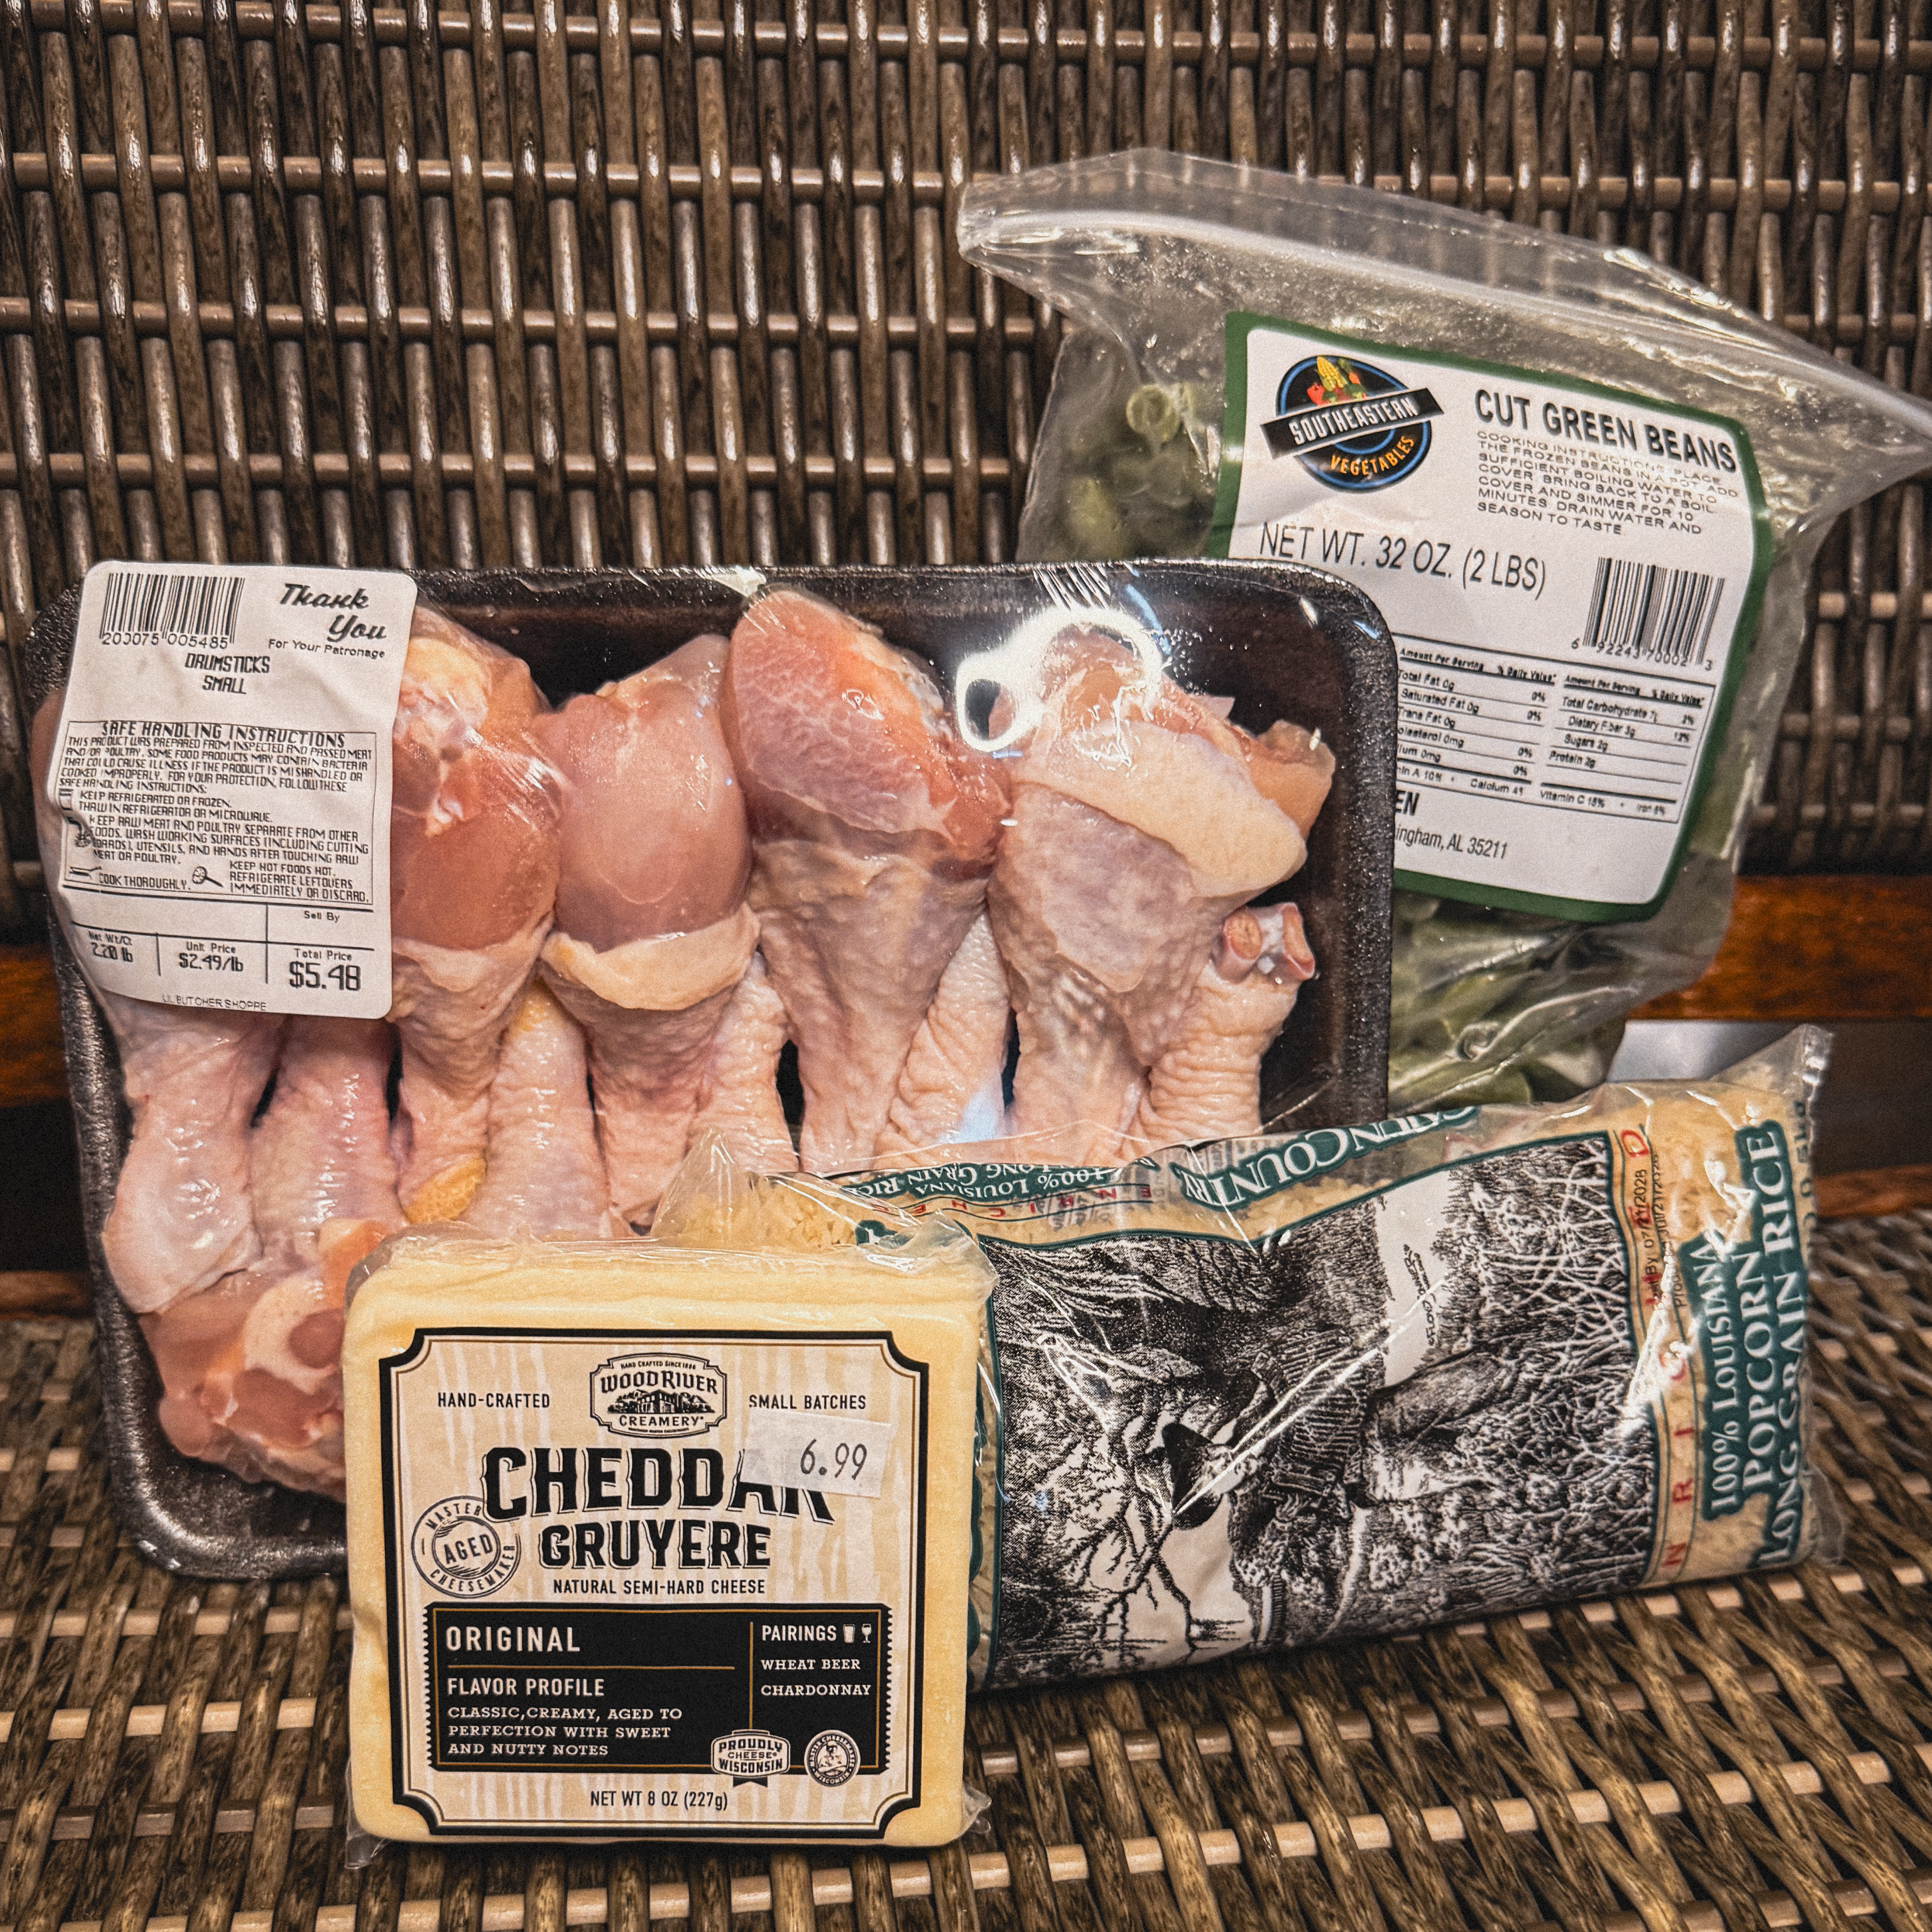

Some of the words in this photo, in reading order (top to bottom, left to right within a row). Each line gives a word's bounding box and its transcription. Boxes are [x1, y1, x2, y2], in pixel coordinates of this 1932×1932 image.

[1289, 397, 1418, 445] SOUTHEASTERN
[1475, 389, 1530, 430] CUT
[1542, 402, 1637, 450] GREEN
[1644, 424, 1736, 473] BEANS
[1478, 431, 1548, 450] COOKING
[1330, 436, 1414, 476] VEGETABLES
[1479, 440, 1507, 453] THE
[1513, 447, 1575, 465] FROZEN
[1581, 461, 1631, 476] BEANS
[1707, 485, 1738, 497] ADD
[1479, 453, 1568, 475] SUFFICIENT
[1575, 470, 1633, 487] BOILING
[1638, 482, 1692, 500] WATER
[1698, 494, 1717, 504] TO
[1479, 464, 1533, 480] COVER
[1544, 475, 1590, 490] BRING
[1596, 484, 1636, 498] BACK
[1643, 493, 1661, 503] TO
[1666, 497, 1675, 506] A
[1681, 499, 1714, 514] BOIL
[1479, 476, 1533, 493] COVER
[1538, 487, 1571, 500] AND
[1577, 493, 1635, 511] SIMMER
[1642, 505, 1671, 518] FOR
[1679, 512, 1693, 522] 10
[1478, 502, 1542, 521] SEASON
[1548, 514, 1568, 525] TO
[1574, 518, 1621, 535] TASTE
[1479, 488, 1547, 508] MINUTES
[1557, 502, 1604, 518] DRAIN
[1609, 511, 1665, 528] WATER
[1669, 522, 1702, 534] AND
[1260, 522, 1315, 560] NET
[1322, 528, 1365, 567] WT.
[1375, 535, 1407, 570] 32
[1413, 540, 1452, 579] OZ.
[1462, 547, 1486, 590] (2
[1492, 551, 1546, 601] LBS)
[279, 583, 369, 610] Thank
[326, 615, 387, 642] You
[168, 633, 228, 649] 005485
[268, 638, 288, 649] For
[293, 640, 321, 652] Your
[324, 644, 385, 660] Patronage
[184, 653, 270, 673] DRUMSTICKS
[1705, 660, 1712, 671] 3
[202, 675, 247, 695] SMALL
[101, 721, 137, 736] SAFE
[142, 722, 222, 739] HANDLING
[229, 724, 346, 748] INSTRUCTIONS
[108, 792, 175, 804] REFRIGERATED
[177, 795, 190, 805] OR
[192, 796, 232, 808] FROZEN.
[1446, 834, 1464, 853] AL
[1467, 837, 1507, 859] 35211
[230, 860, 256, 870] KEEP
[260, 862, 277, 871] HOT
[281, 864, 312, 875] FOODS
[315, 867, 336, 877] HOT.
[124, 875, 191, 890] THOROUGHLY.
[304, 910, 322, 920] Sell
[327, 912, 340, 923] By
[88, 931, 102, 941] Net
[186, 941, 205, 952] Unit
[211, 943, 236, 954] Price
[294, 948, 322, 960] Total
[327, 950, 352, 962] Price
[121, 947, 134, 963] lb
[179, 953, 244, 972] $2.49/lb
[289, 961, 361, 991] $5.48
[176, 995, 223, 1007] BUTCHER
[225, 999, 267, 1011] SHOPPE
[907, 1164, 977, 1186] GRAIN
[1037, 1167, 1107, 1190] 100%
[915, 1178, 1027, 1200] LOUISIANA
[1747, 1131, 1795, 1256] RICE
[1646, 1257, 1660, 1274] By
[1690, 1242, 1739, 1412] LOUISIANA
[1772, 1271, 1807, 1430] GRAIN
[665, 1360, 681, 1368] SINCE
[1731, 1250, 1777, 1491] POPCORN
[438, 1392, 550, 1408] HAND-CRAFTED
[749, 1395, 797, 1409] SMALL
[804, 1395, 867, 1409] BATCHES
[800, 1439, 867, 1481] 6.99
[1711, 1420, 1741, 1508] 100%
[1757, 1443, 1798, 1562] LONG
[426, 1503, 482, 1530] MASTER
[444, 1534, 494, 1565] AGED
[539, 1519, 771, 1570] GRUYERE
[430, 1546, 516, 1592] CHEESEMAKER
[553, 1580, 617, 1594] NATURAL
[623, 1580, 704, 1594] SEMI-HARD
[711, 1580, 766, 1595] CHEESE
[446, 1626, 580, 1652] ORIGINAL
[762, 1625, 837, 1641] PAIRINGS
[761, 1659, 816, 1670] WHEAT
[821, 1659, 861, 1670] BEER
[447, 1678, 517, 1696] FLAVOR
[527, 1678, 605, 1696] PROFILE
[761, 1684, 872, 1696] CHARDONNAY
[608, 1708, 653, 1720] AGED
[660, 1708, 682, 1720] TO
[448, 1725, 557, 1738] PERFECTION
[563, 1727, 609, 1738] WITH
[615, 1727, 671, 1738] SWEET
[448, 1743, 485, 1755] AND
[491, 1744, 547, 1756] NUTTY
[552, 1744, 609, 1756] NOTES
[718, 1739, 783, 1753] PROUDLY
[718, 1758, 783, 1773] WISCONSIN
[591, 1791, 616, 1806] NET
[621, 1791, 642, 1806] WT
[648, 1790, 655, 1806] 8
[662, 1791, 678, 1806] OZ
[684, 1791, 728, 1811] (227g)
